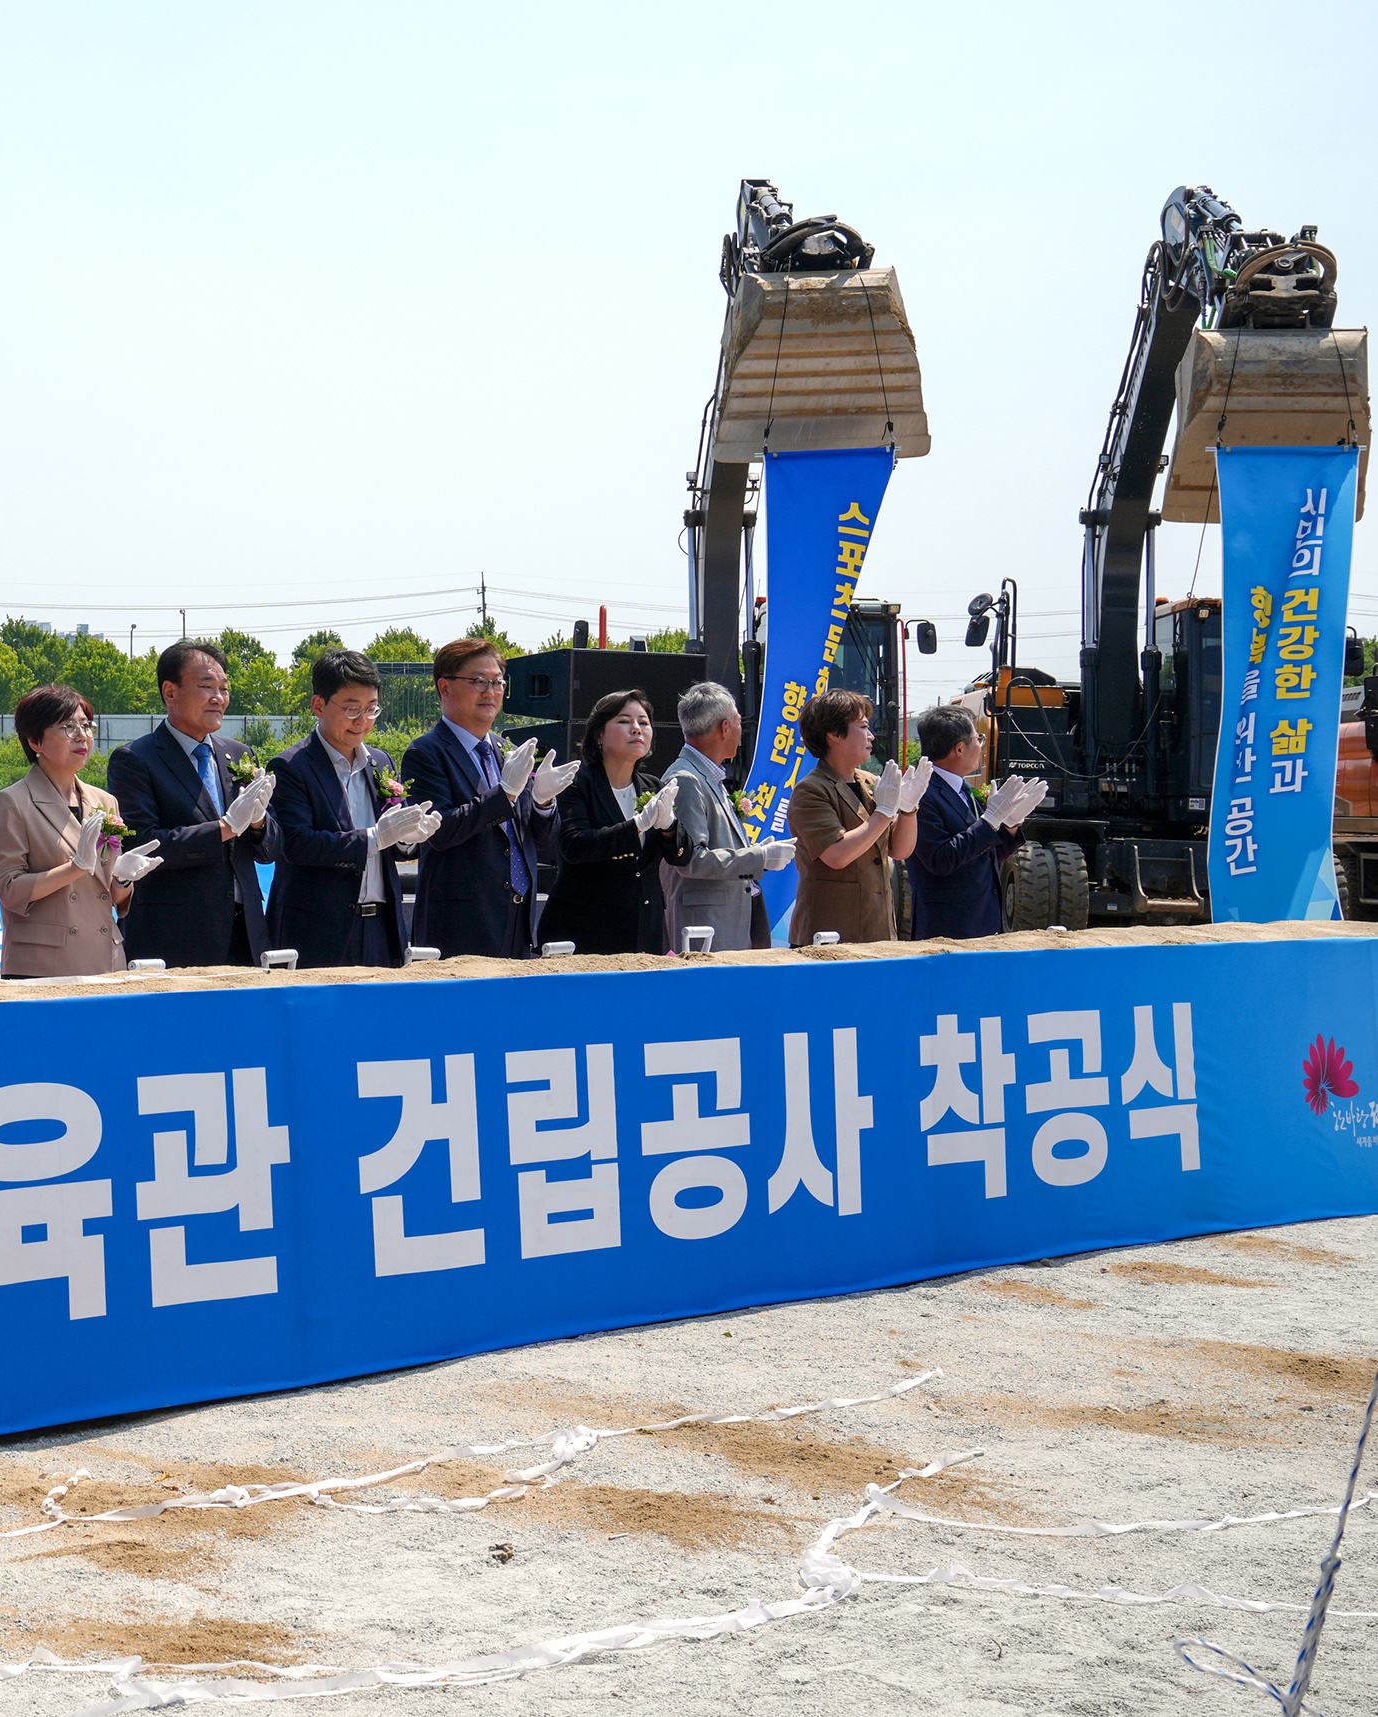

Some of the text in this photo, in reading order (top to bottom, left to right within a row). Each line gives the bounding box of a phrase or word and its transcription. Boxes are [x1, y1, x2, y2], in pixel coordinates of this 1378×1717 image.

[769, 680, 809, 765] 향한
[1269, 487, 1328, 794] 시민의 건강한 삶과
[1224, 795, 1259, 876] 공간
[356, 1026, 875, 1277] 건립공사
[918, 1001, 1201, 1199] 착공식
